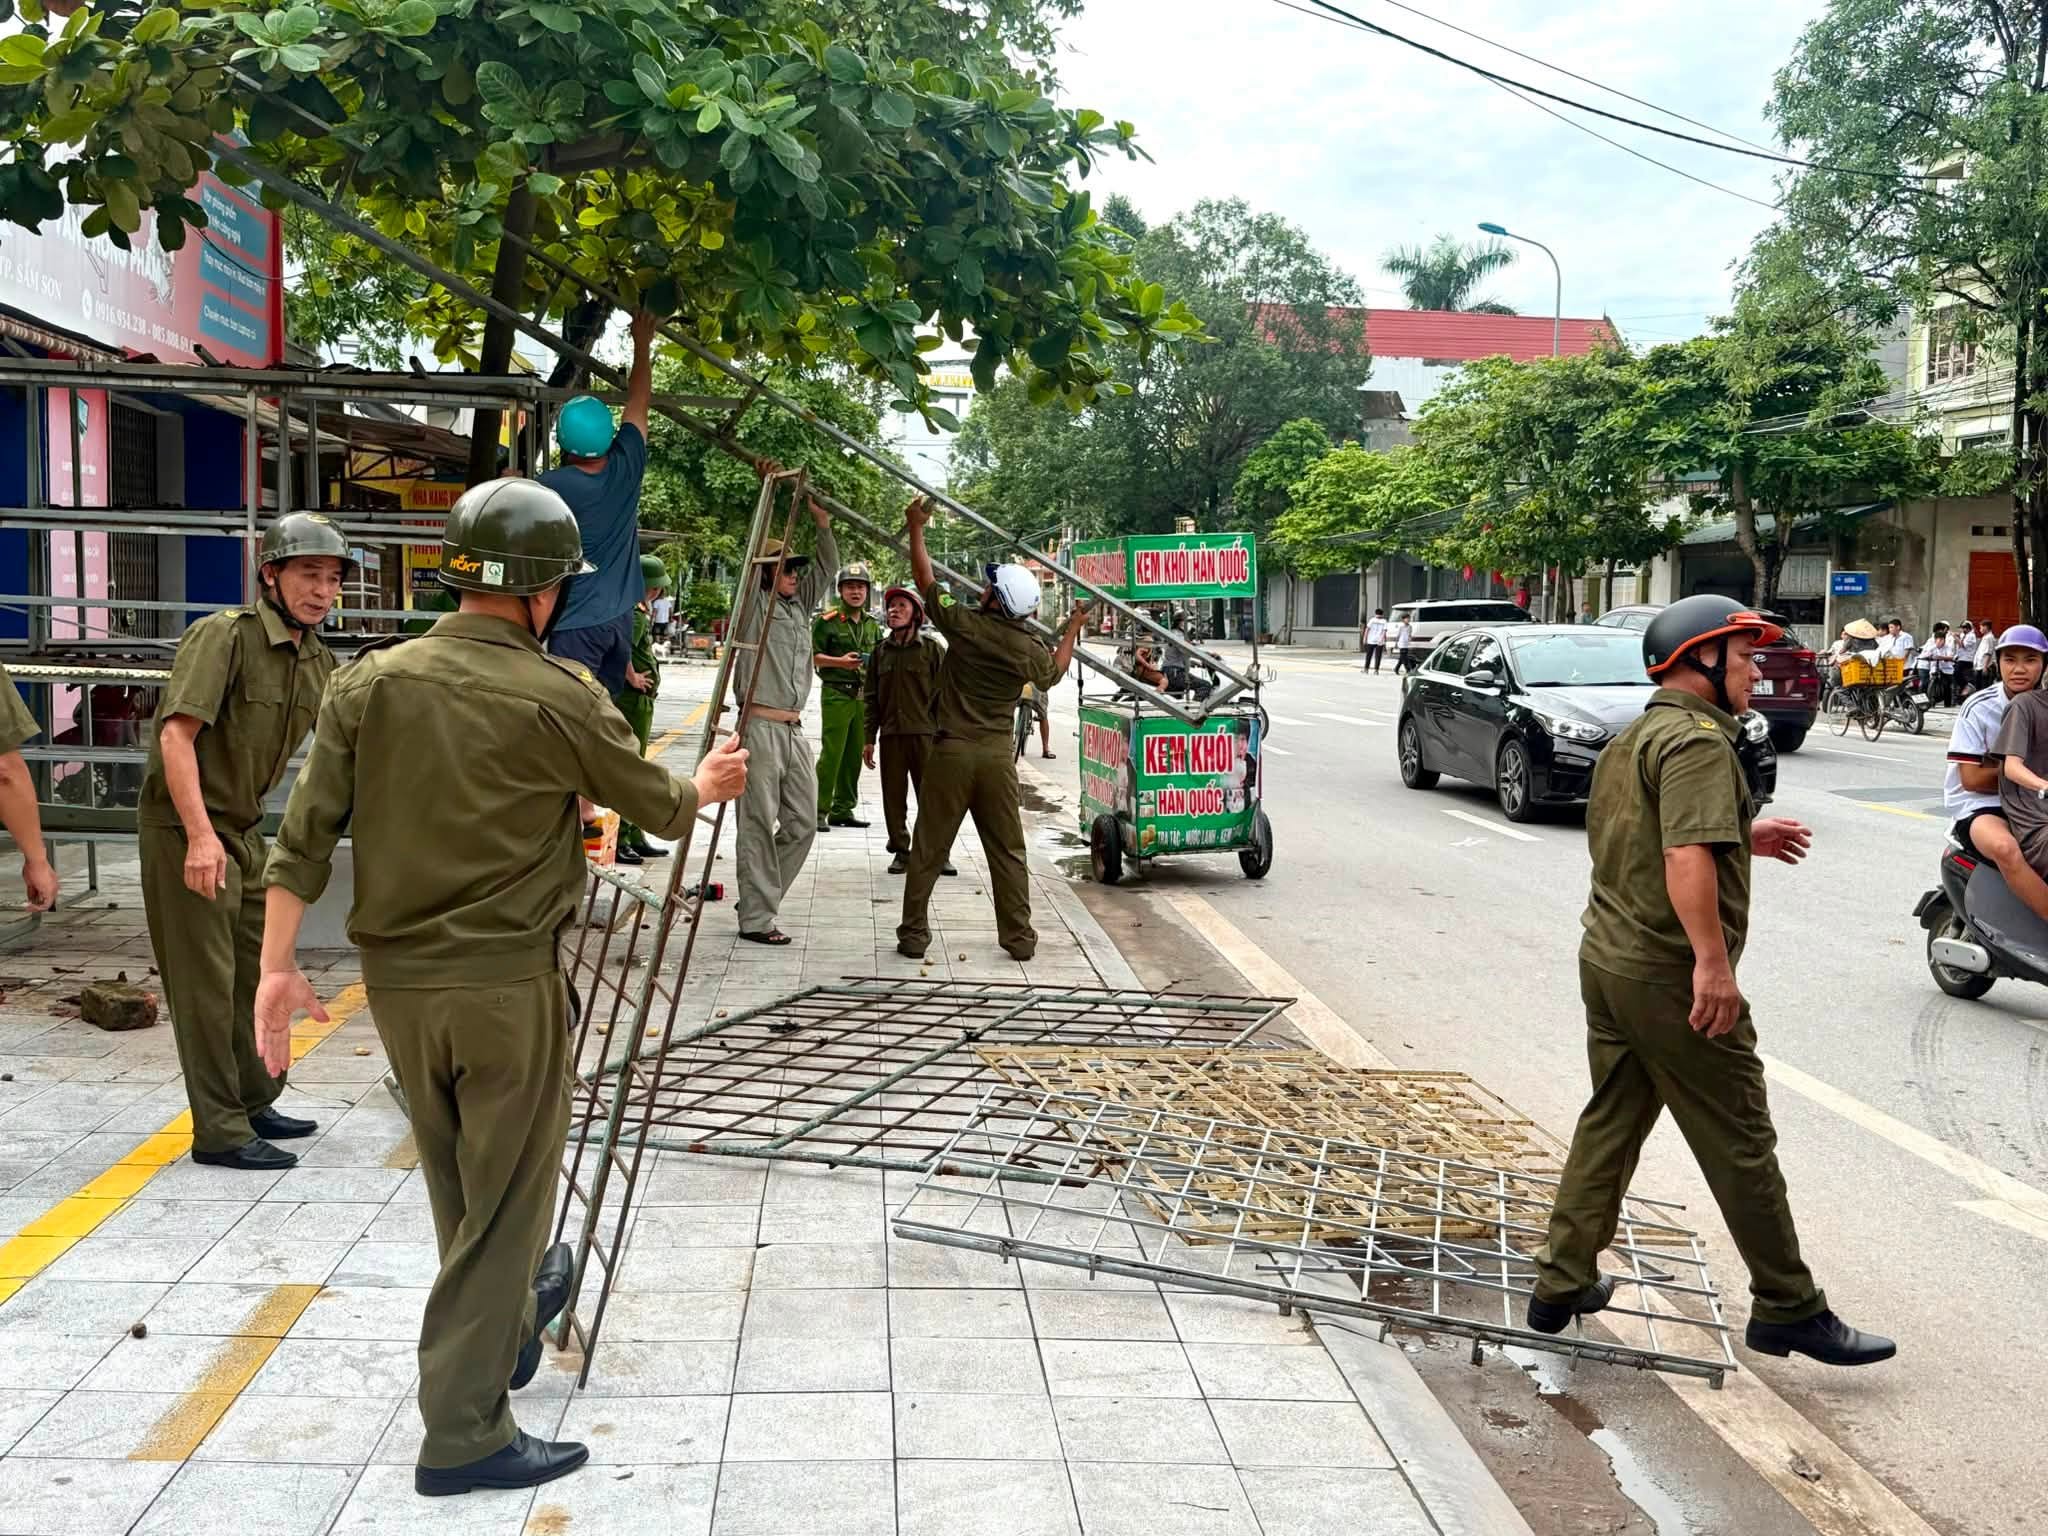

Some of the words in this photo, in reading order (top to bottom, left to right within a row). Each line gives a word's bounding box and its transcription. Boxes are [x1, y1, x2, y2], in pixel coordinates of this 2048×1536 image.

[1136, 551, 1161, 585] KEM
[1163, 542, 1190, 585] KHÓI
[1193, 542, 1215, 584] HÀN
[1218, 536, 1248, 588] QUỐC
[1083, 721, 1100, 763] KEM
[1101, 721, 1121, 769] KHÓI
[1145, 733, 1186, 775] KEM
[1190, 725, 1233, 774] KHÓI
[1157, 783, 1186, 816] HÀN
[1188, 779, 1224, 818] QUỐC
